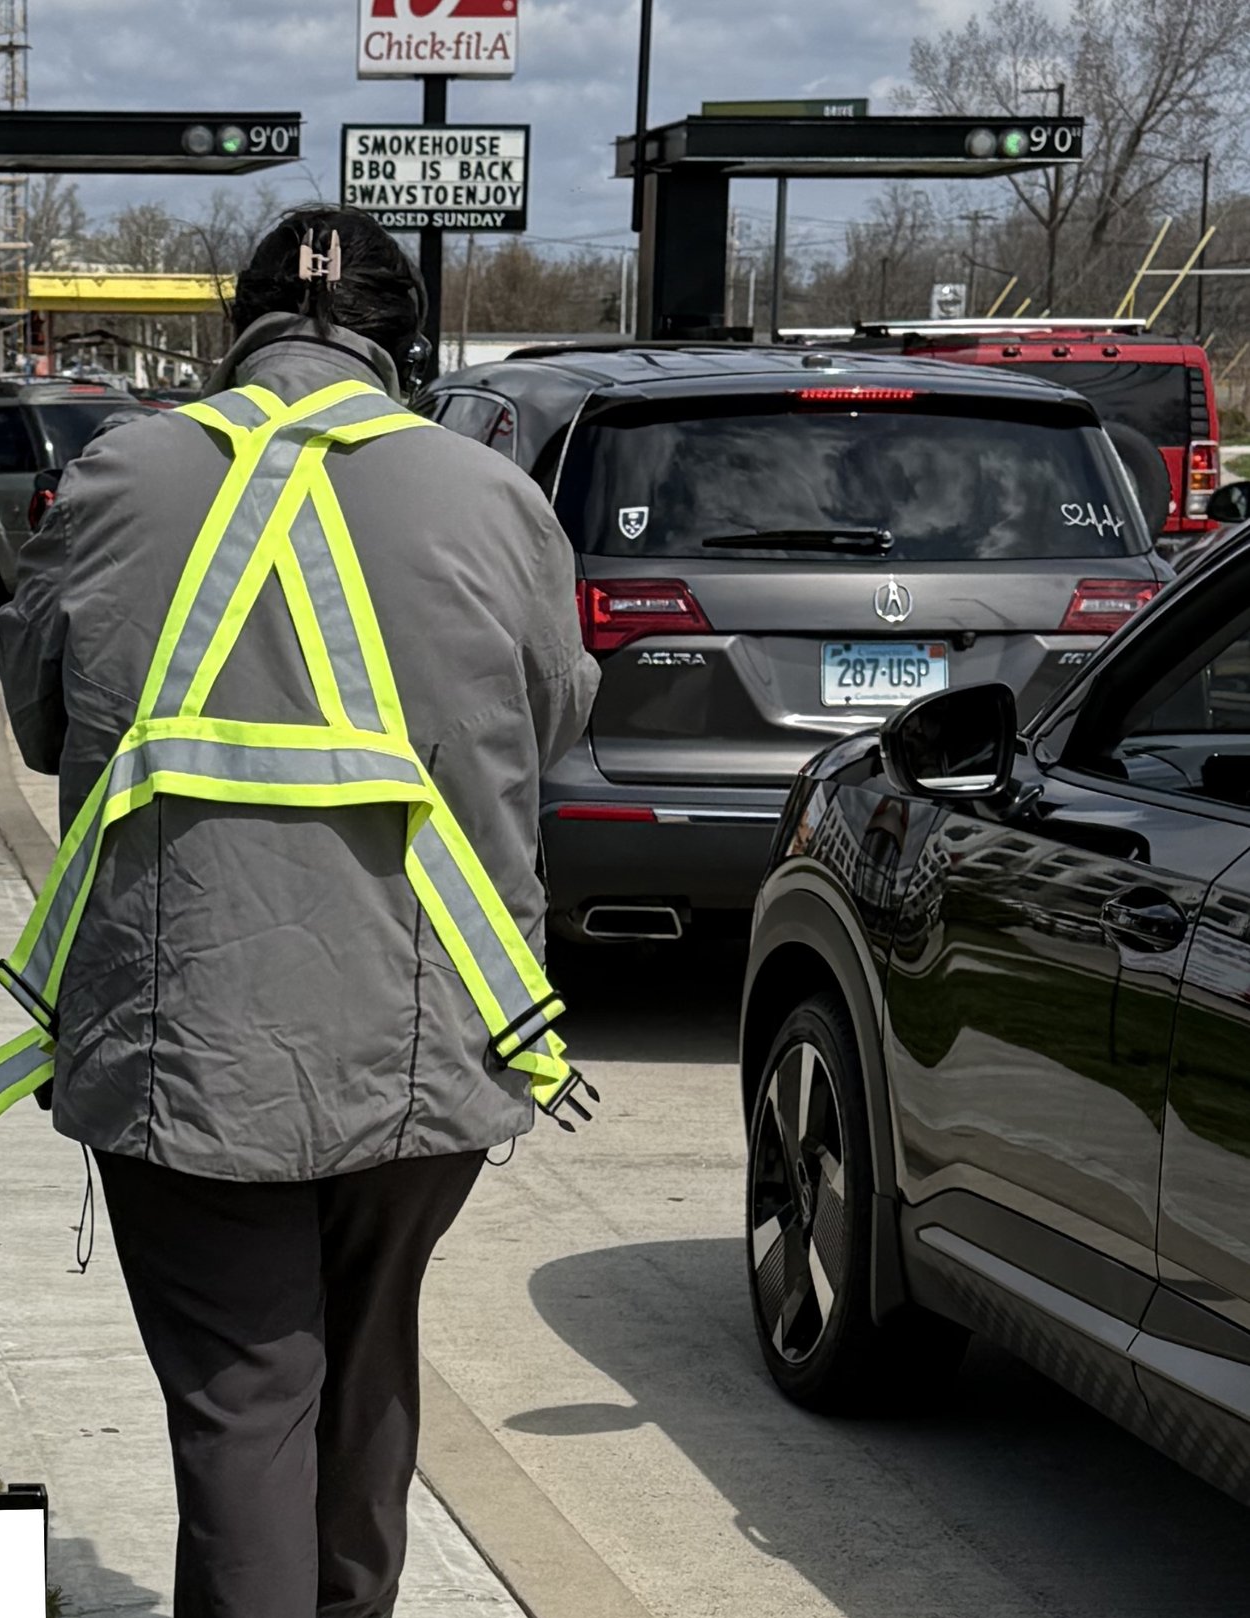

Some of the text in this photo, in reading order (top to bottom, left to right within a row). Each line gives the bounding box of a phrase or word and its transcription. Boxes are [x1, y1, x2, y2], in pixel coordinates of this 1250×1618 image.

[364, 31, 510, 61] Chick-fil-A
[358, 135, 501, 156] SMOKEHOUSE
[352, 160, 513, 181] BBQ IS BACK
[368, 212, 506, 227] LOSED SUNDAY
